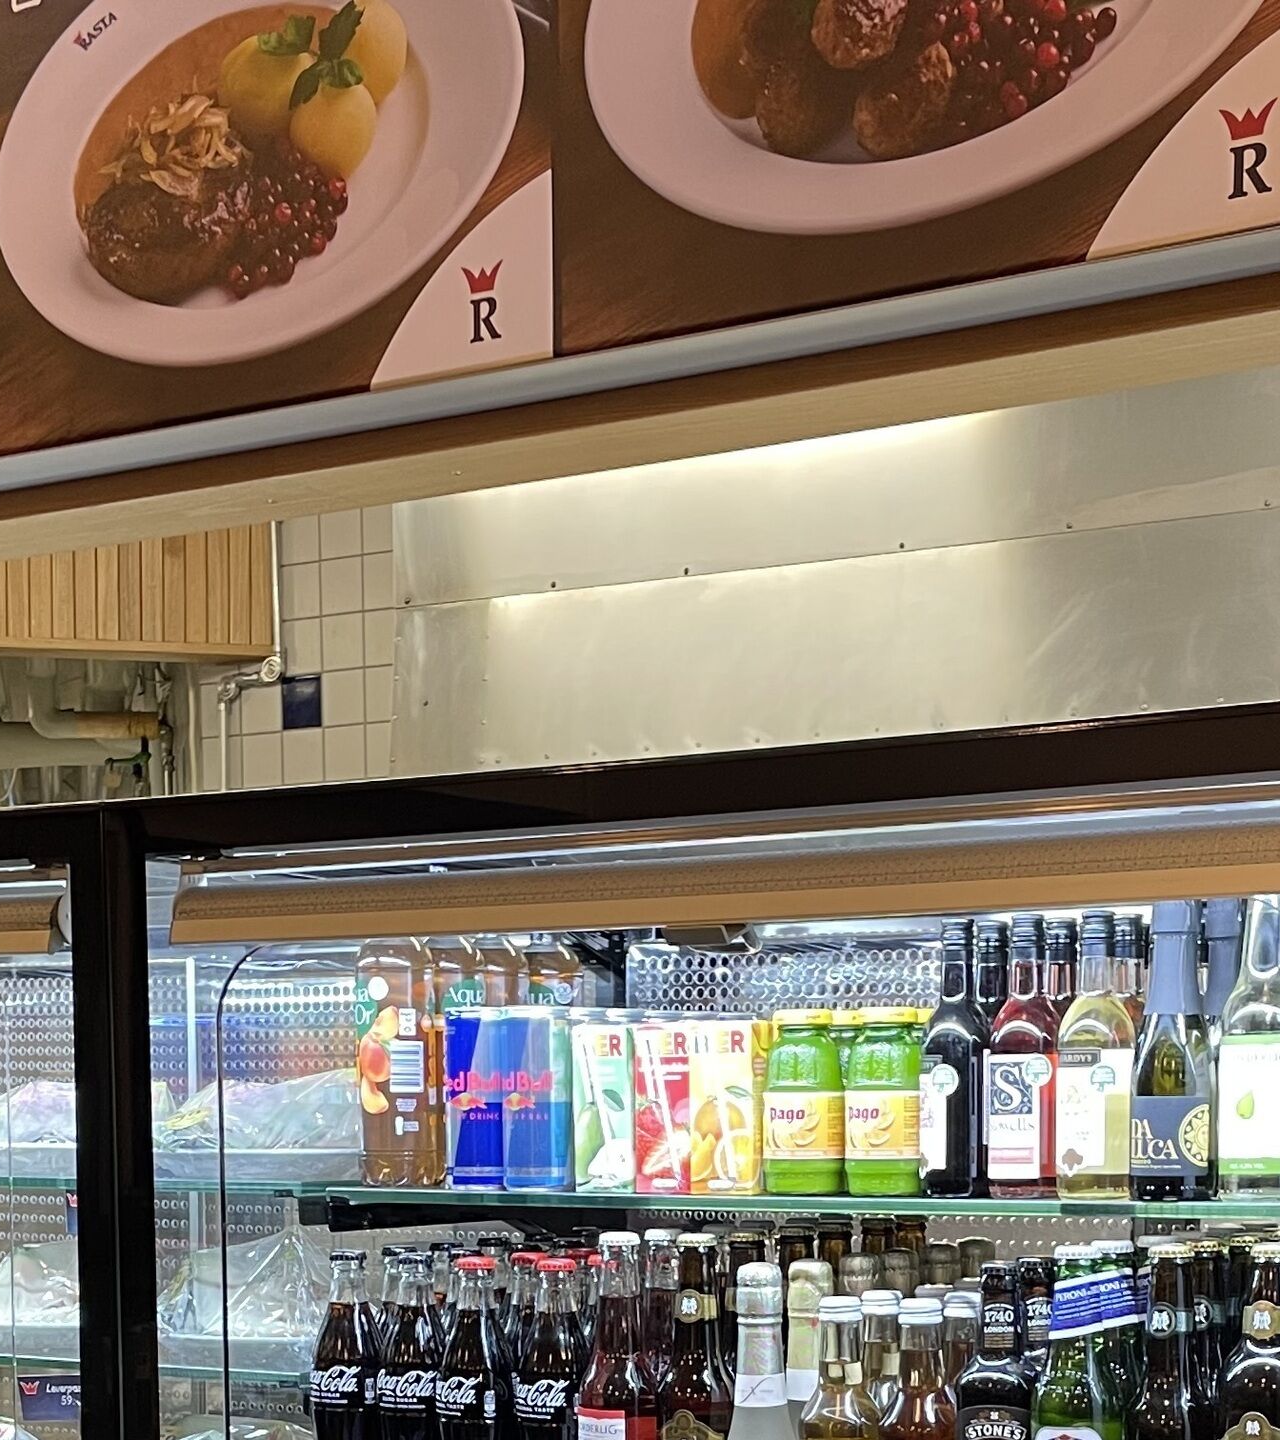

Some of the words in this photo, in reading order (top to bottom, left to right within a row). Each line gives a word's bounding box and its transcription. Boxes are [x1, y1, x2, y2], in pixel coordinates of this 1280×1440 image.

[80, 12, 118, 51] RASTA
[1225, 142, 1273, 200] R
[468, 299, 503, 346] R
[770, 1106, 805, 1124] pago
[849, 1106, 879, 1124] pago
[985, 1311, 1014, 1323] 1740
